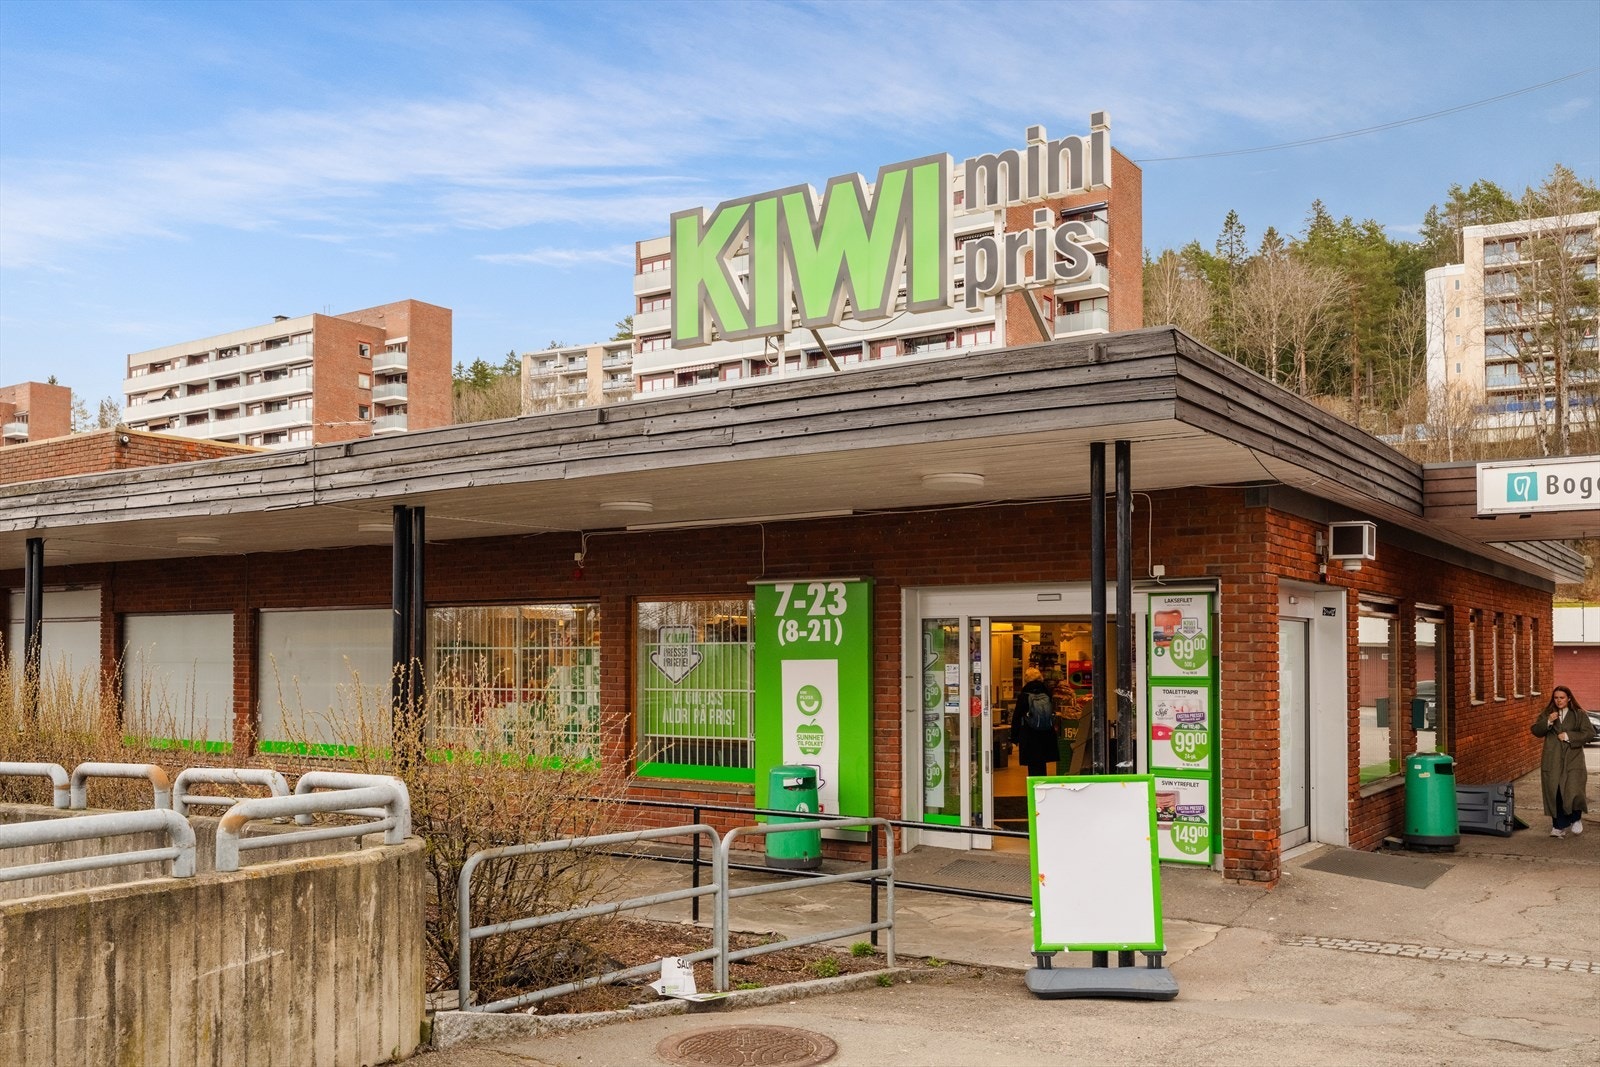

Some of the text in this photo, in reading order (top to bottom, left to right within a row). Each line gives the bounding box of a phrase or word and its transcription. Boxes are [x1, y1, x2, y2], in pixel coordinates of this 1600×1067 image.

[963, 110, 1111, 214] mini
[670, 152, 954, 350] KIWI
[964, 207, 1096, 313] pris
[1546, 474, 1600, 499] Bog
[774, 582, 847, 617] 7-23
[777, 617, 843, 647] (8-21)
